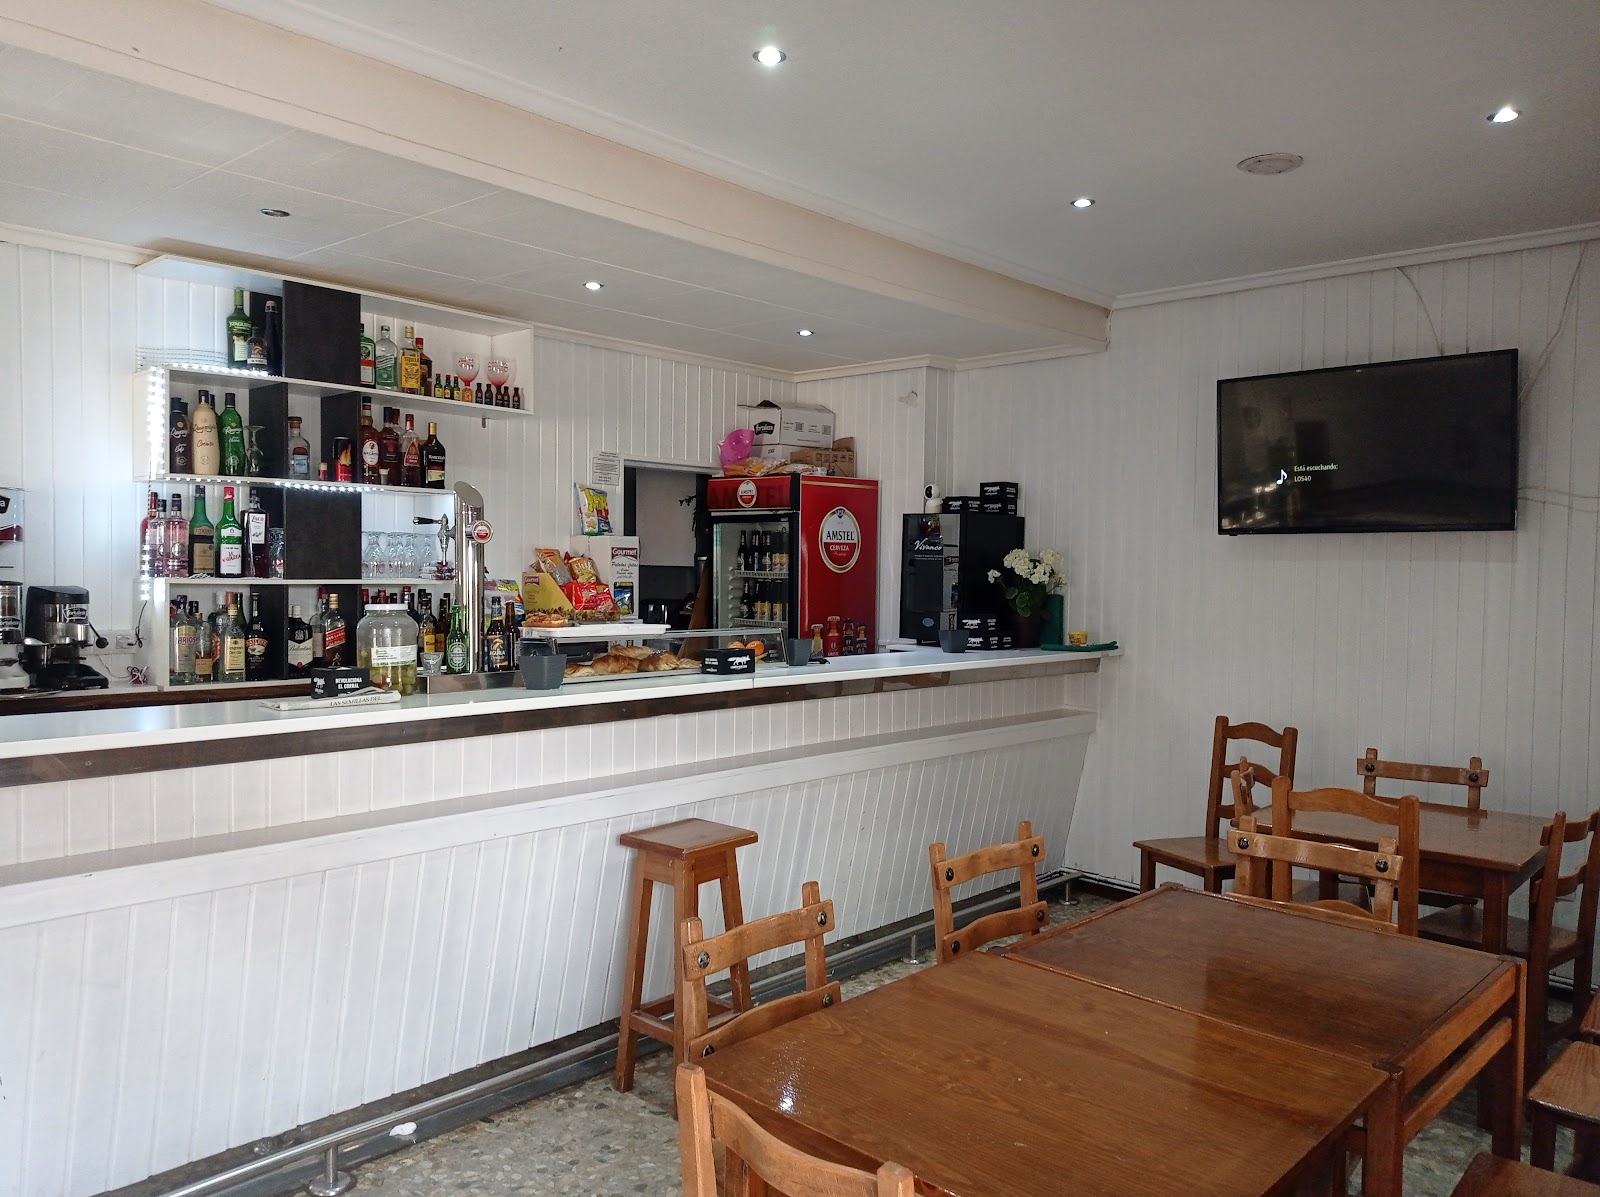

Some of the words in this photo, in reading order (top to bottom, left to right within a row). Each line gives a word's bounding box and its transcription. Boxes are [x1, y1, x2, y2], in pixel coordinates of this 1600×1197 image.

[1306, 463, 1339, 471] escuchando:
[826, 530, 855, 541] AMSTEL
[612, 547, 637, 556] Gourmet
[344, 682, 360, 690] CORRAL
[369, 695, 382, 703] DEL
